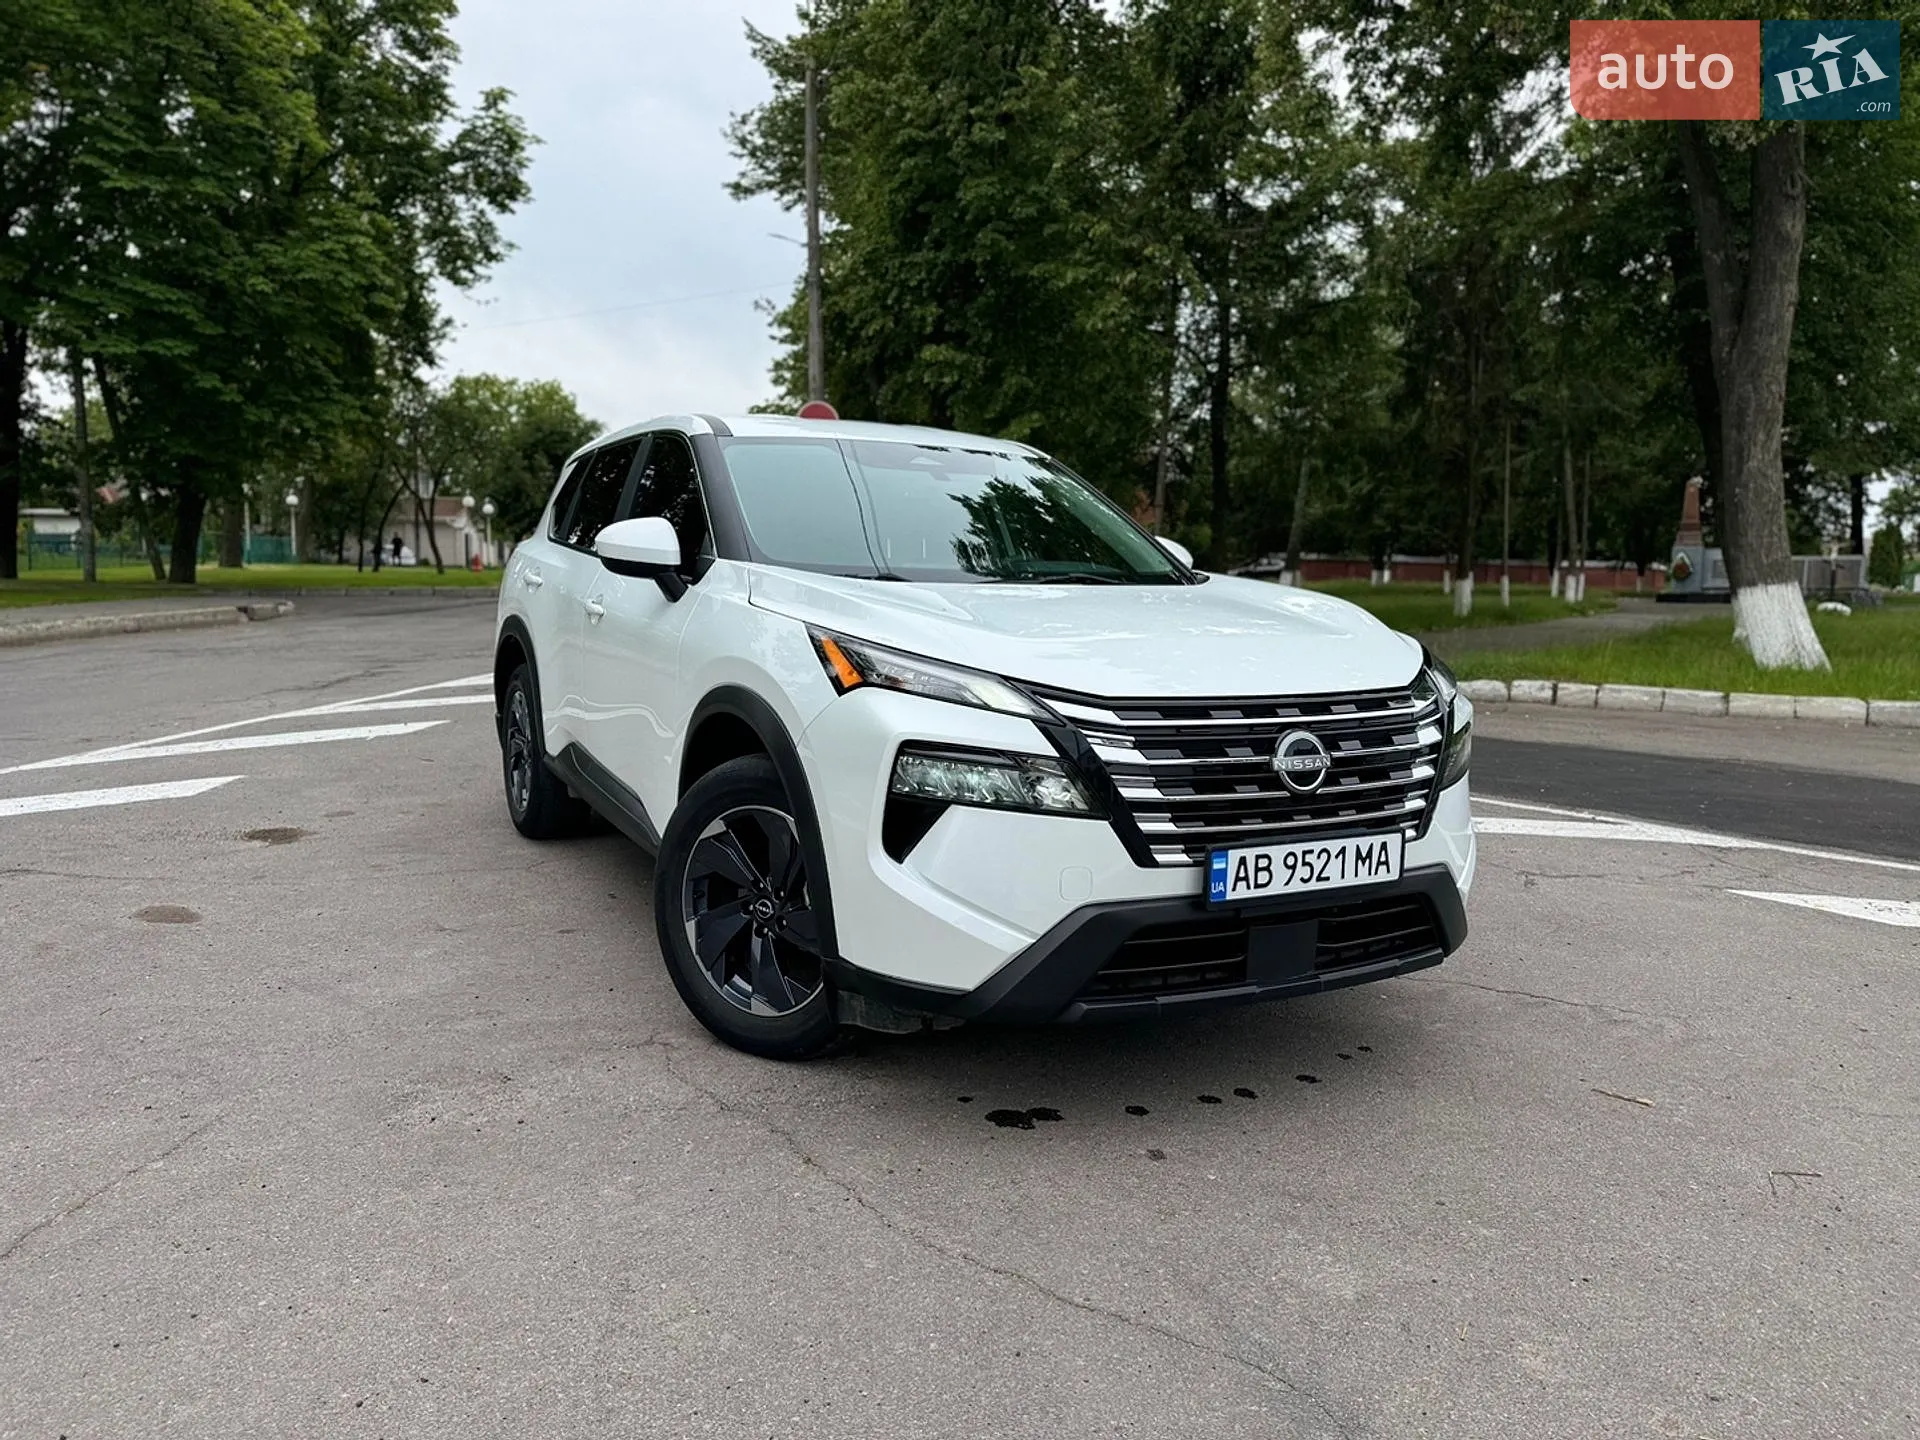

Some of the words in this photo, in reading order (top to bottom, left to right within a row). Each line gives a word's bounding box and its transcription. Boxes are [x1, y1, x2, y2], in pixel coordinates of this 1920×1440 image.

[1274, 754, 1331, 770] NISSAN
[1231, 854, 1273, 892] AB
[1283, 845, 1347, 887] 9521
[1354, 841, 1391, 878] MA
[1211, 882, 1225, 894] UA
